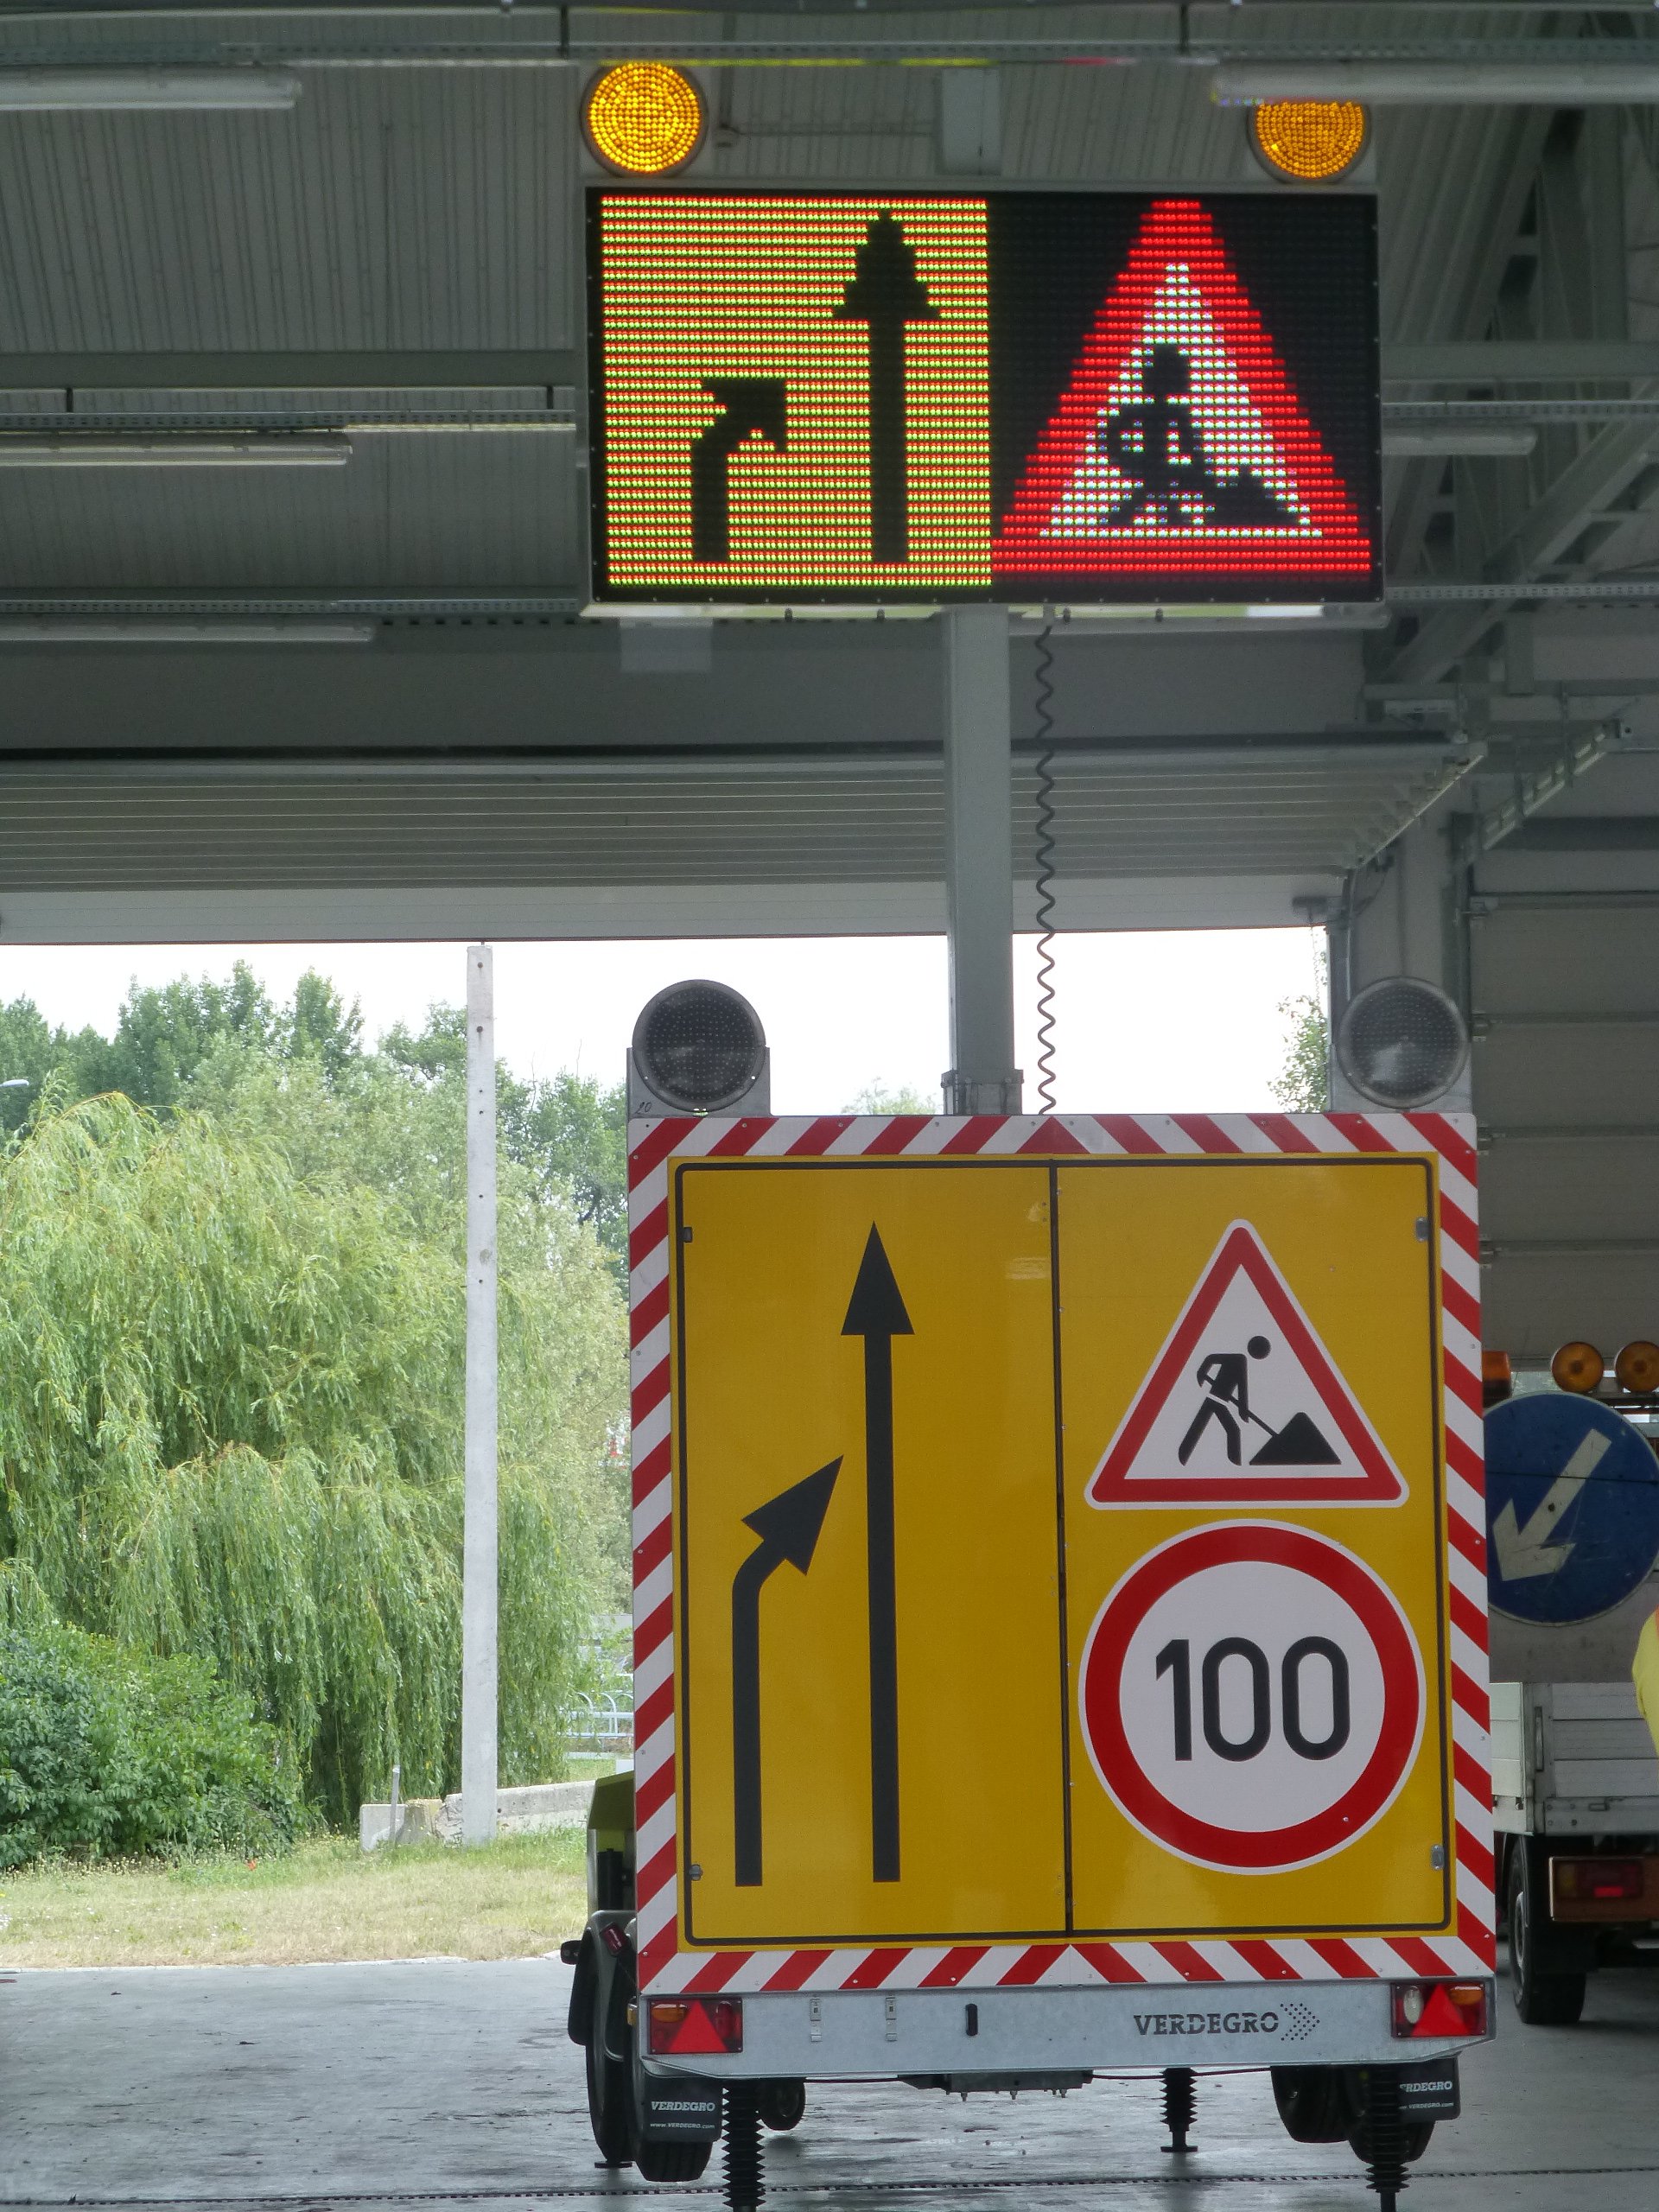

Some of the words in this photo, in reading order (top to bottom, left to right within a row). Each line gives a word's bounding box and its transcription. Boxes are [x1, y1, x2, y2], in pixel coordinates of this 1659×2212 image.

[1155, 1636, 1351, 1762] 100
[1133, 2012, 1279, 2036] VERDEGRO
[651, 2101, 715, 2112] VERDEGRO
